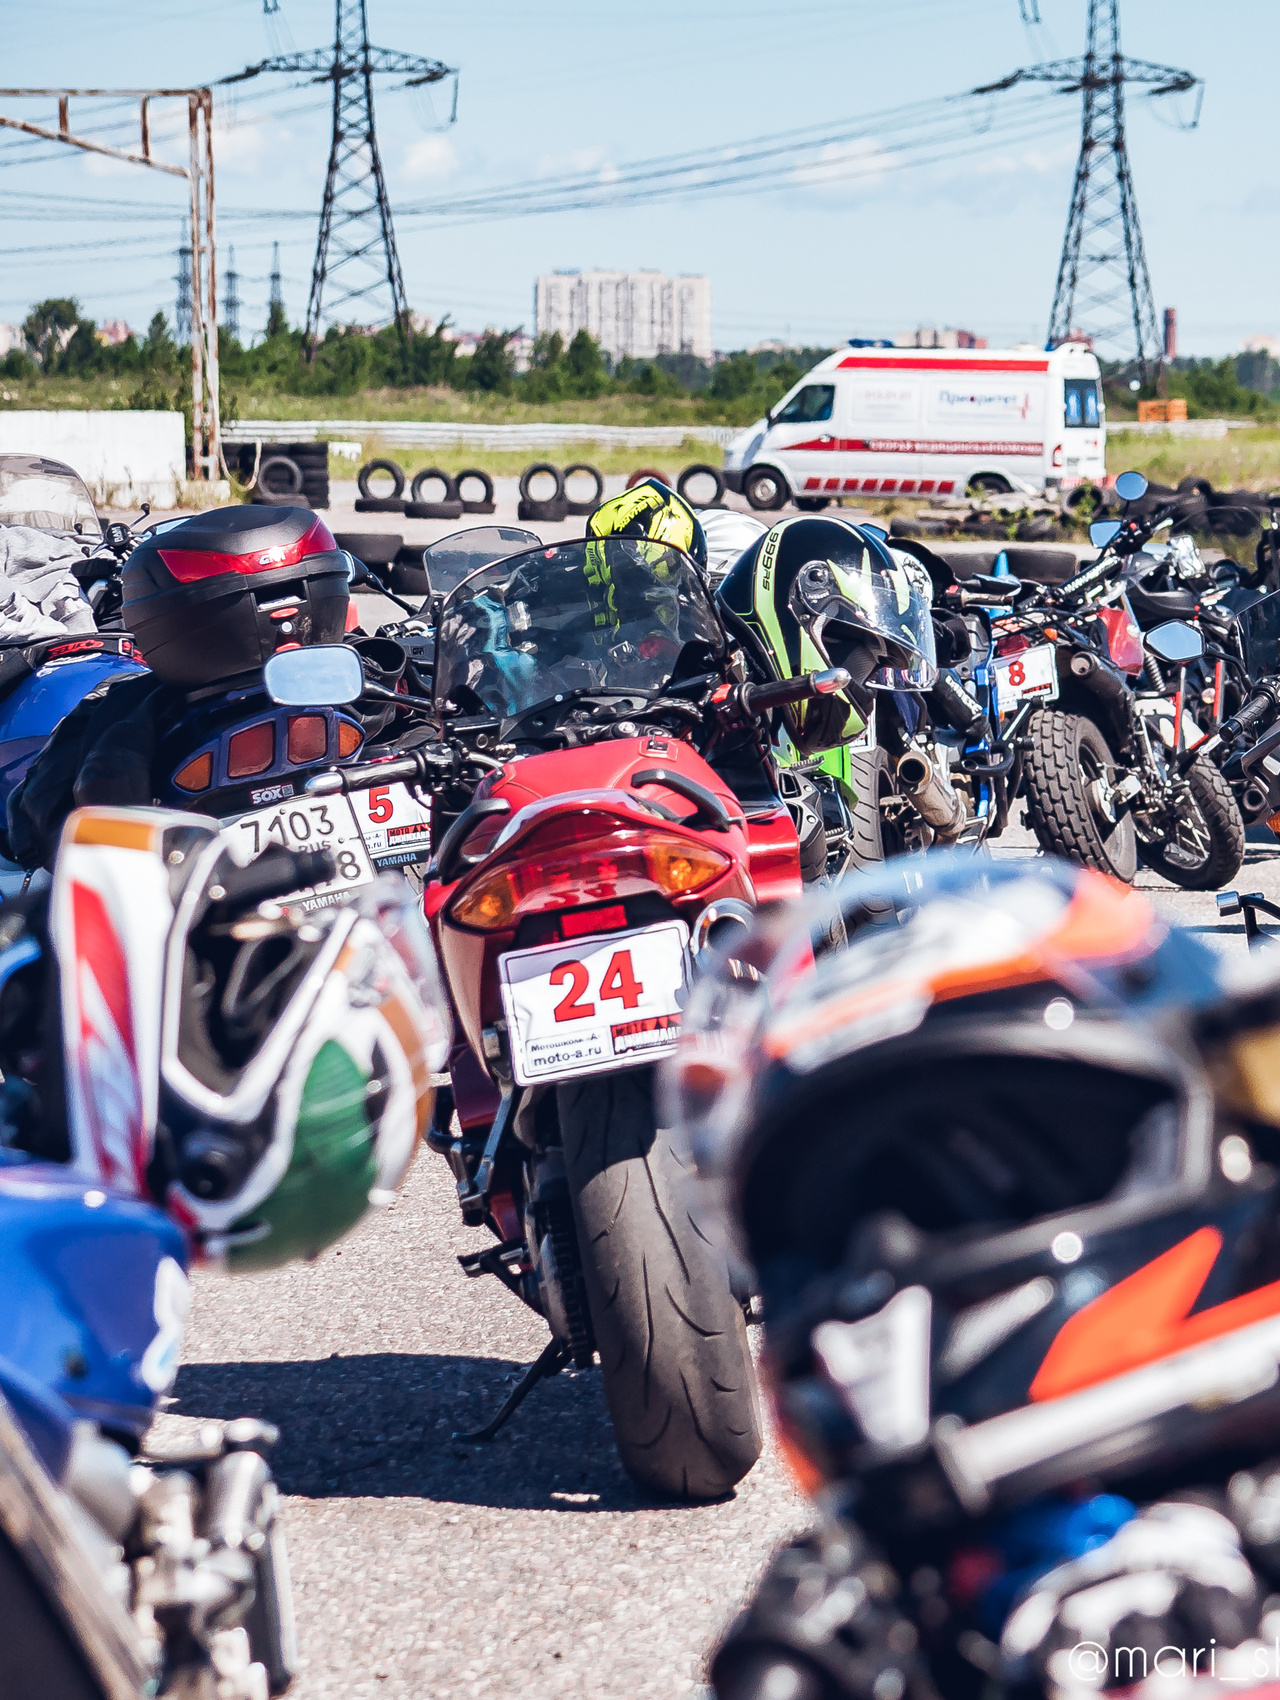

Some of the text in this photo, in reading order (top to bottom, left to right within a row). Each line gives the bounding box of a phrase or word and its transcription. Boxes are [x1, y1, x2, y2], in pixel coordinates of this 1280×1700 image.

[1009, 660, 1026, 686] 8
[252, 788, 283, 804] SOX
[368, 785, 394, 824] 5
[241, 805, 335, 853] 7103
[376, 853, 417, 867] YAMAHA
[549, 949, 643, 1023] 24
[531, 1037, 584, 1052] Мотошкола
[533, 1046, 602, 1067] moto-a.ru
